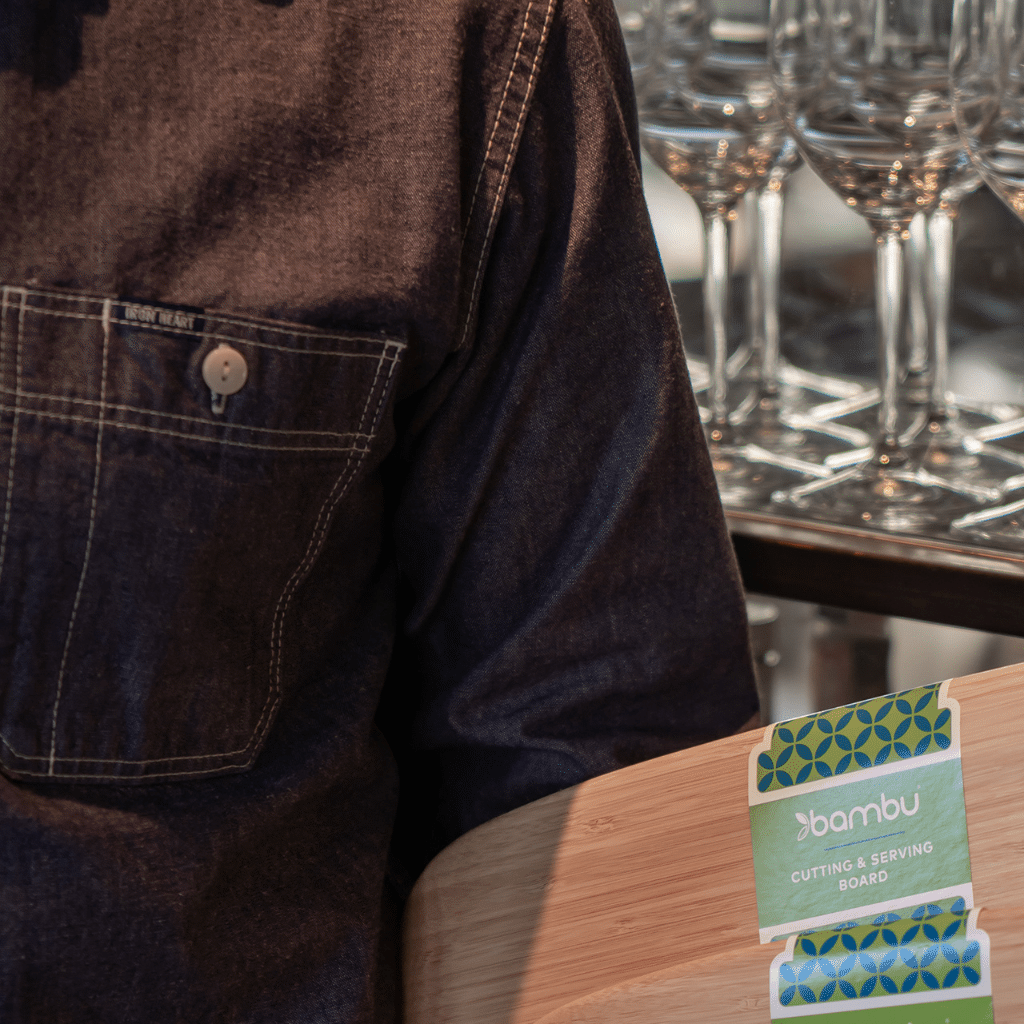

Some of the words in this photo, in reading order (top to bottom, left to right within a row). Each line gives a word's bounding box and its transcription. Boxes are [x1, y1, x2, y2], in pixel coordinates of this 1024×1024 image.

[809, 793, 920, 837] bambu
[791, 860, 853, 883] CUTTING
[857, 857, 867, 869] &
[870, 841, 934, 866] SERVING
[838, 870, 889, 892] BOARD
